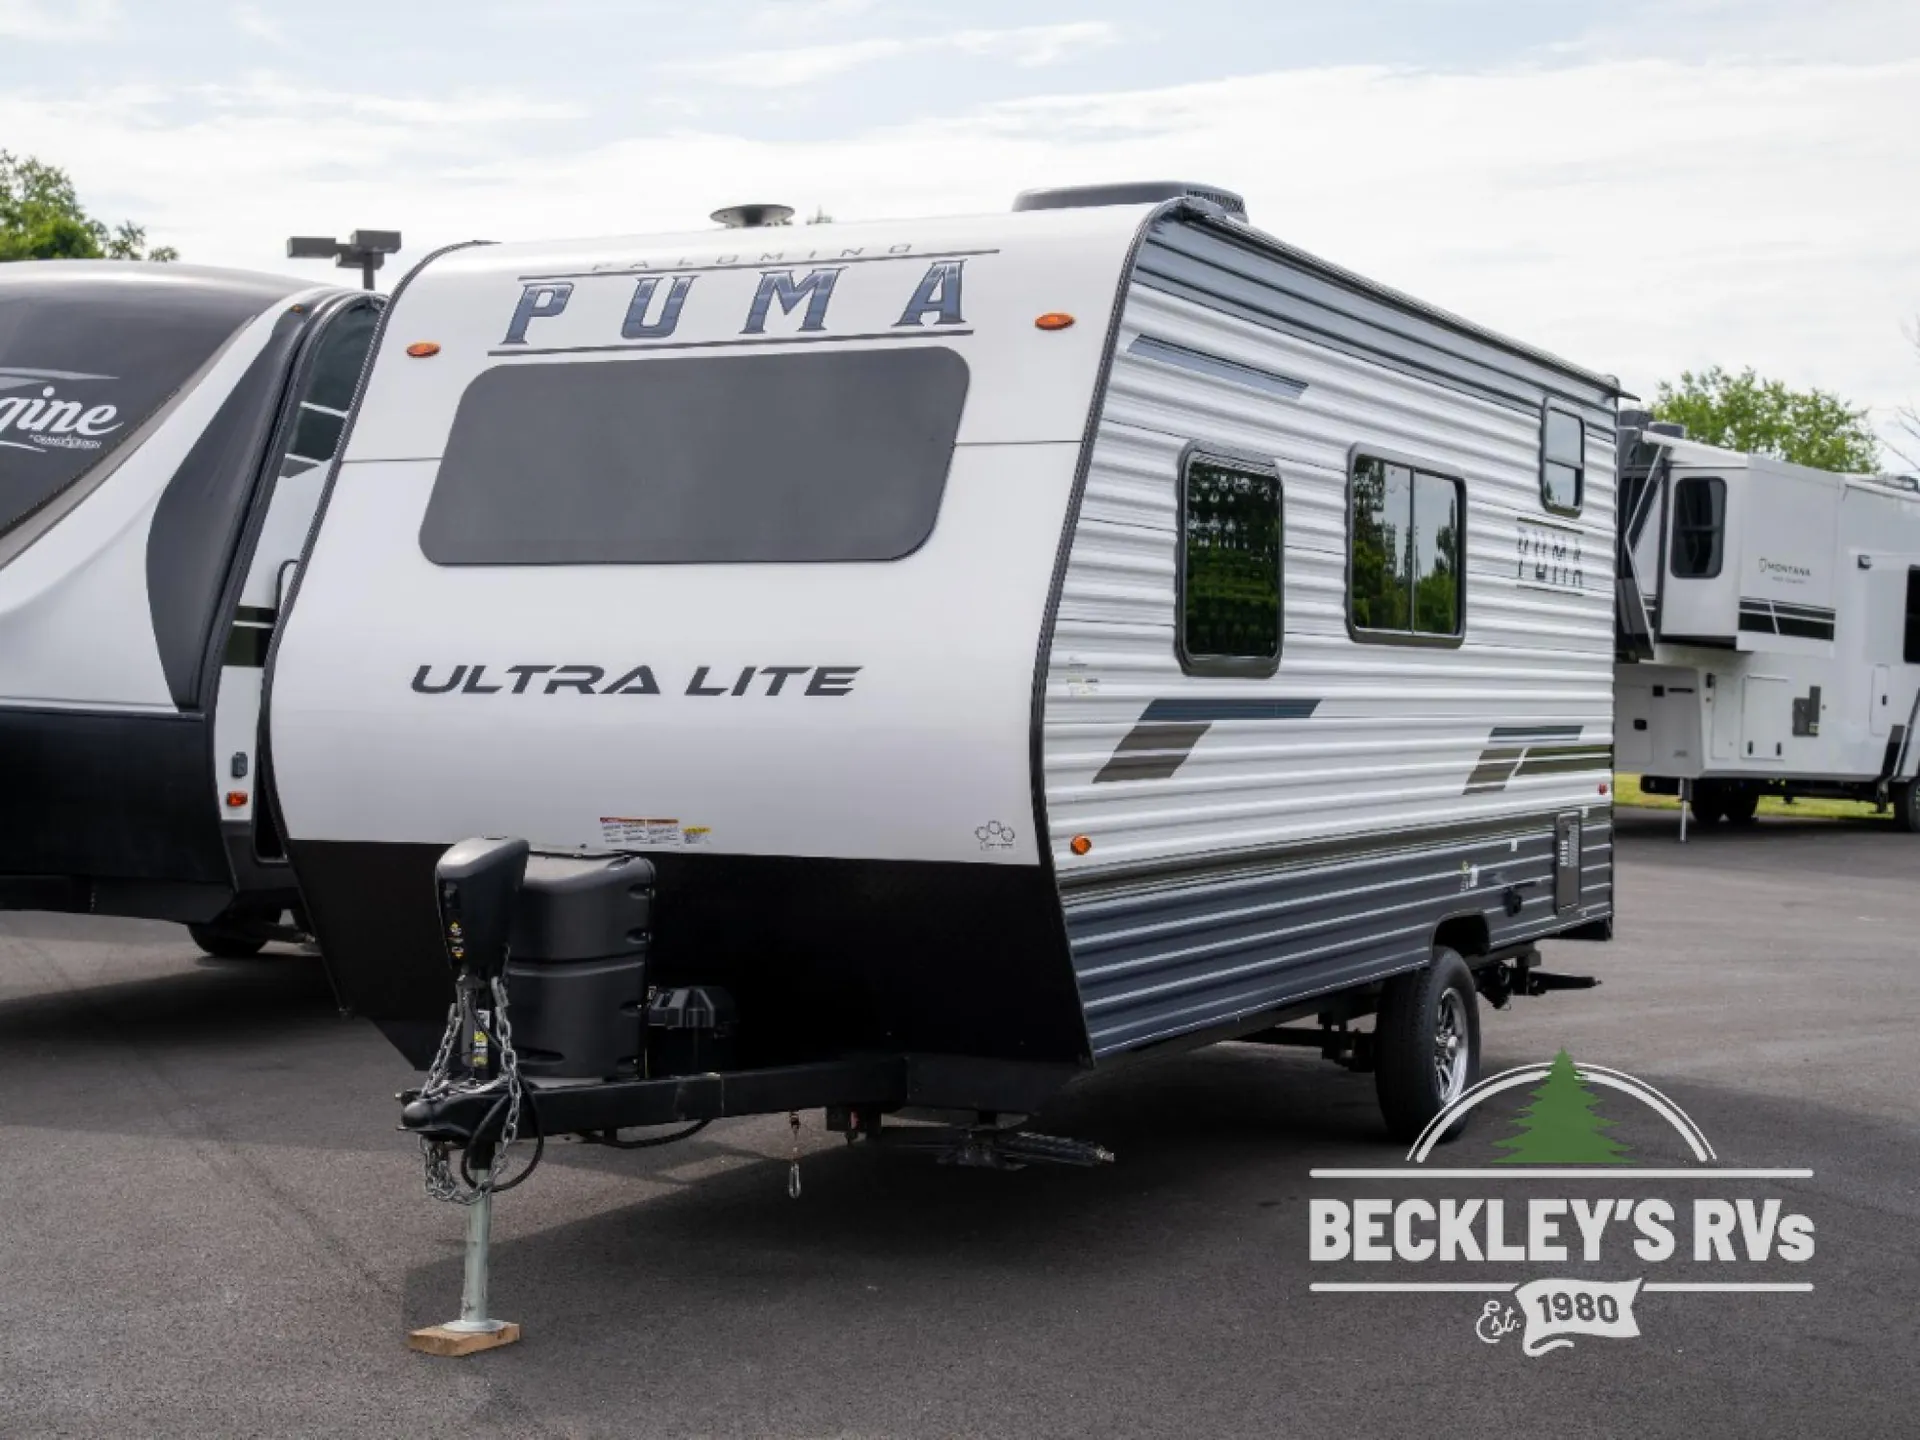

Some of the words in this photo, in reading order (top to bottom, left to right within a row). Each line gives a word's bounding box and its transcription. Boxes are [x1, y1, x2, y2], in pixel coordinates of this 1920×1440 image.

[593, 243, 912, 272] PALOMINO
[501, 258, 968, 345] PUMA
[410, 664, 661, 695] ULTRA
[684, 665, 864, 697] LITE
